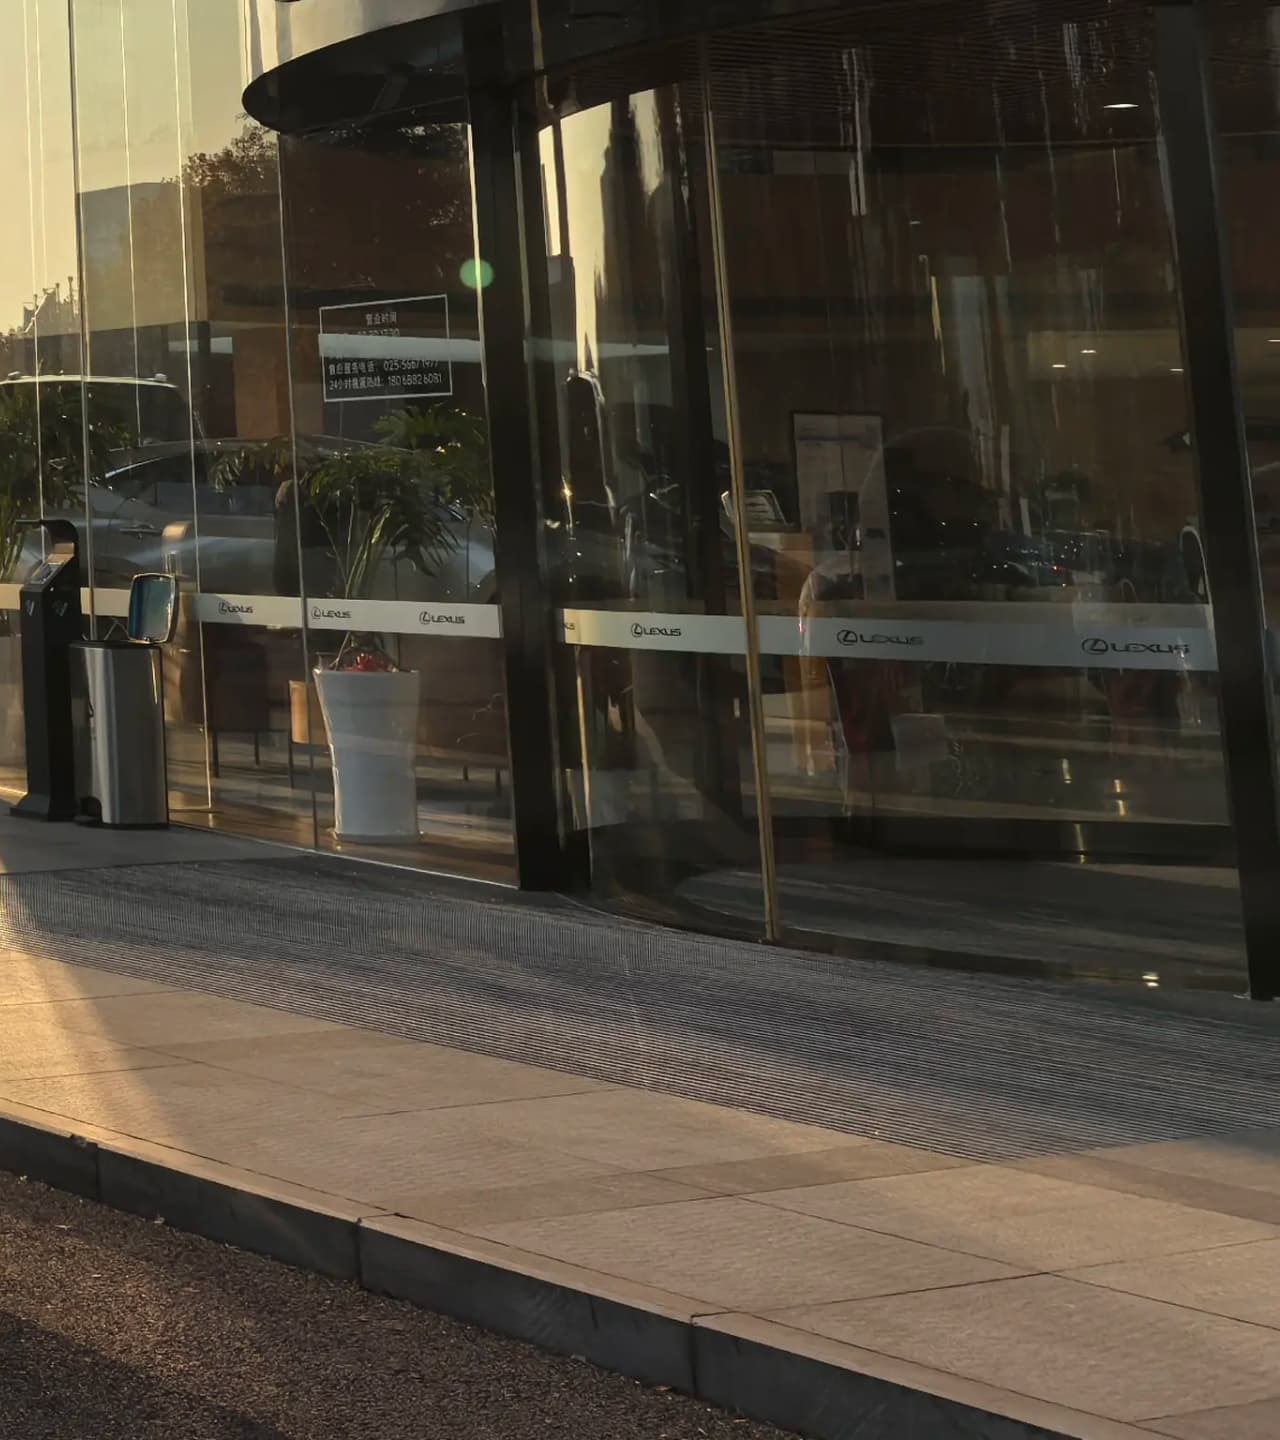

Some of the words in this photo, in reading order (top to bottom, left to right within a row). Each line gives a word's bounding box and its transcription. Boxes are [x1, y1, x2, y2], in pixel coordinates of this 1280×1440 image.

[321, 609, 352, 619] LEXUS
[431, 614, 466, 625] LEXUS
[643, 626, 682, 637] LEXUS
[860, 633, 925, 646] LEXUS
[1111, 641, 1191, 656] LEXUS
